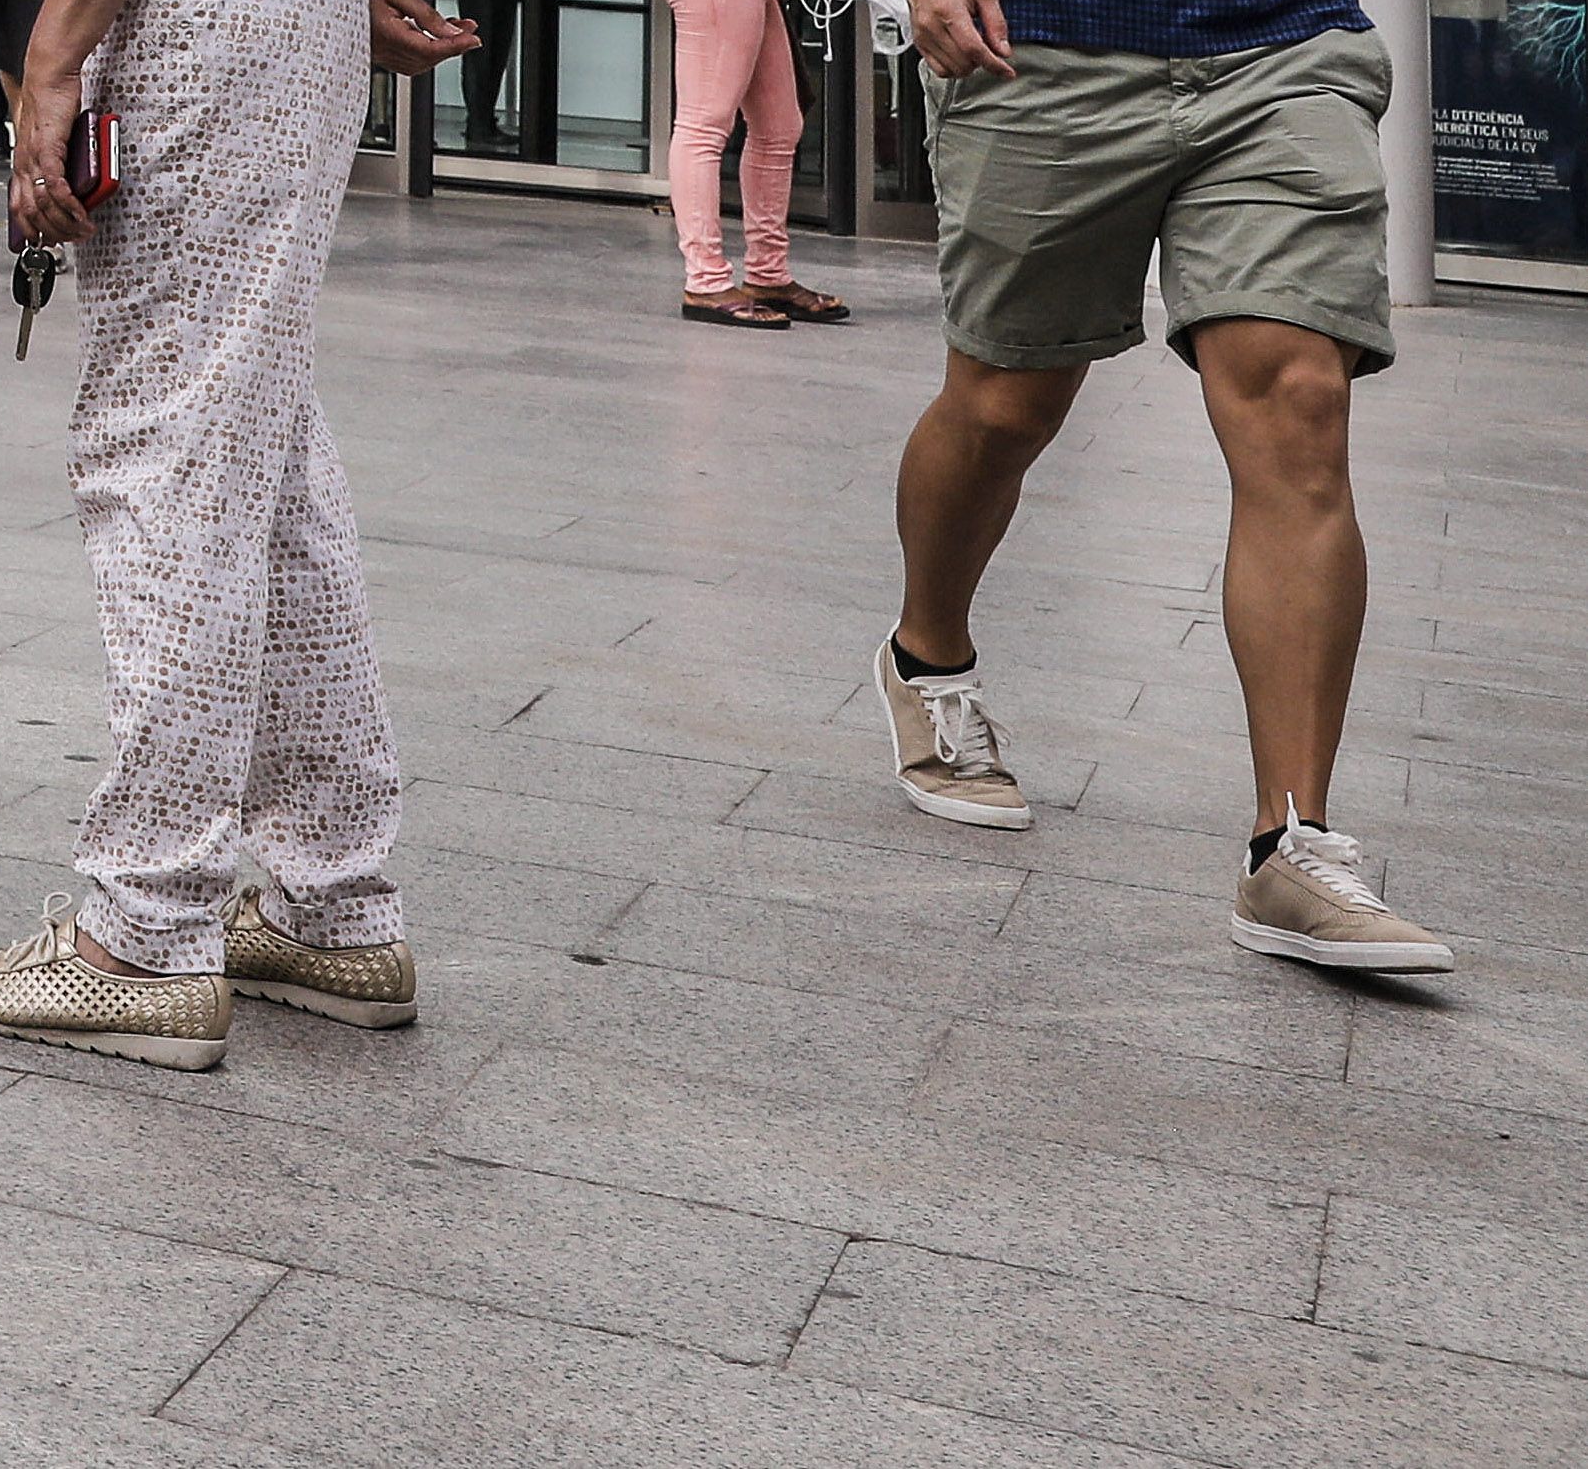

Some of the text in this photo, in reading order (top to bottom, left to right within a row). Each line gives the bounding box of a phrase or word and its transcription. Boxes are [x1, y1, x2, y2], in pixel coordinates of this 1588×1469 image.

[1451, 109, 1524, 126] D'EFICIÈNCIA
[1435, 122, 1549, 141] NERGÈTICA EN SEUS
[1488, 139, 1503, 151] DE
[1505, 141, 1519, 153] LA
[1522, 143, 1537, 153] CV
